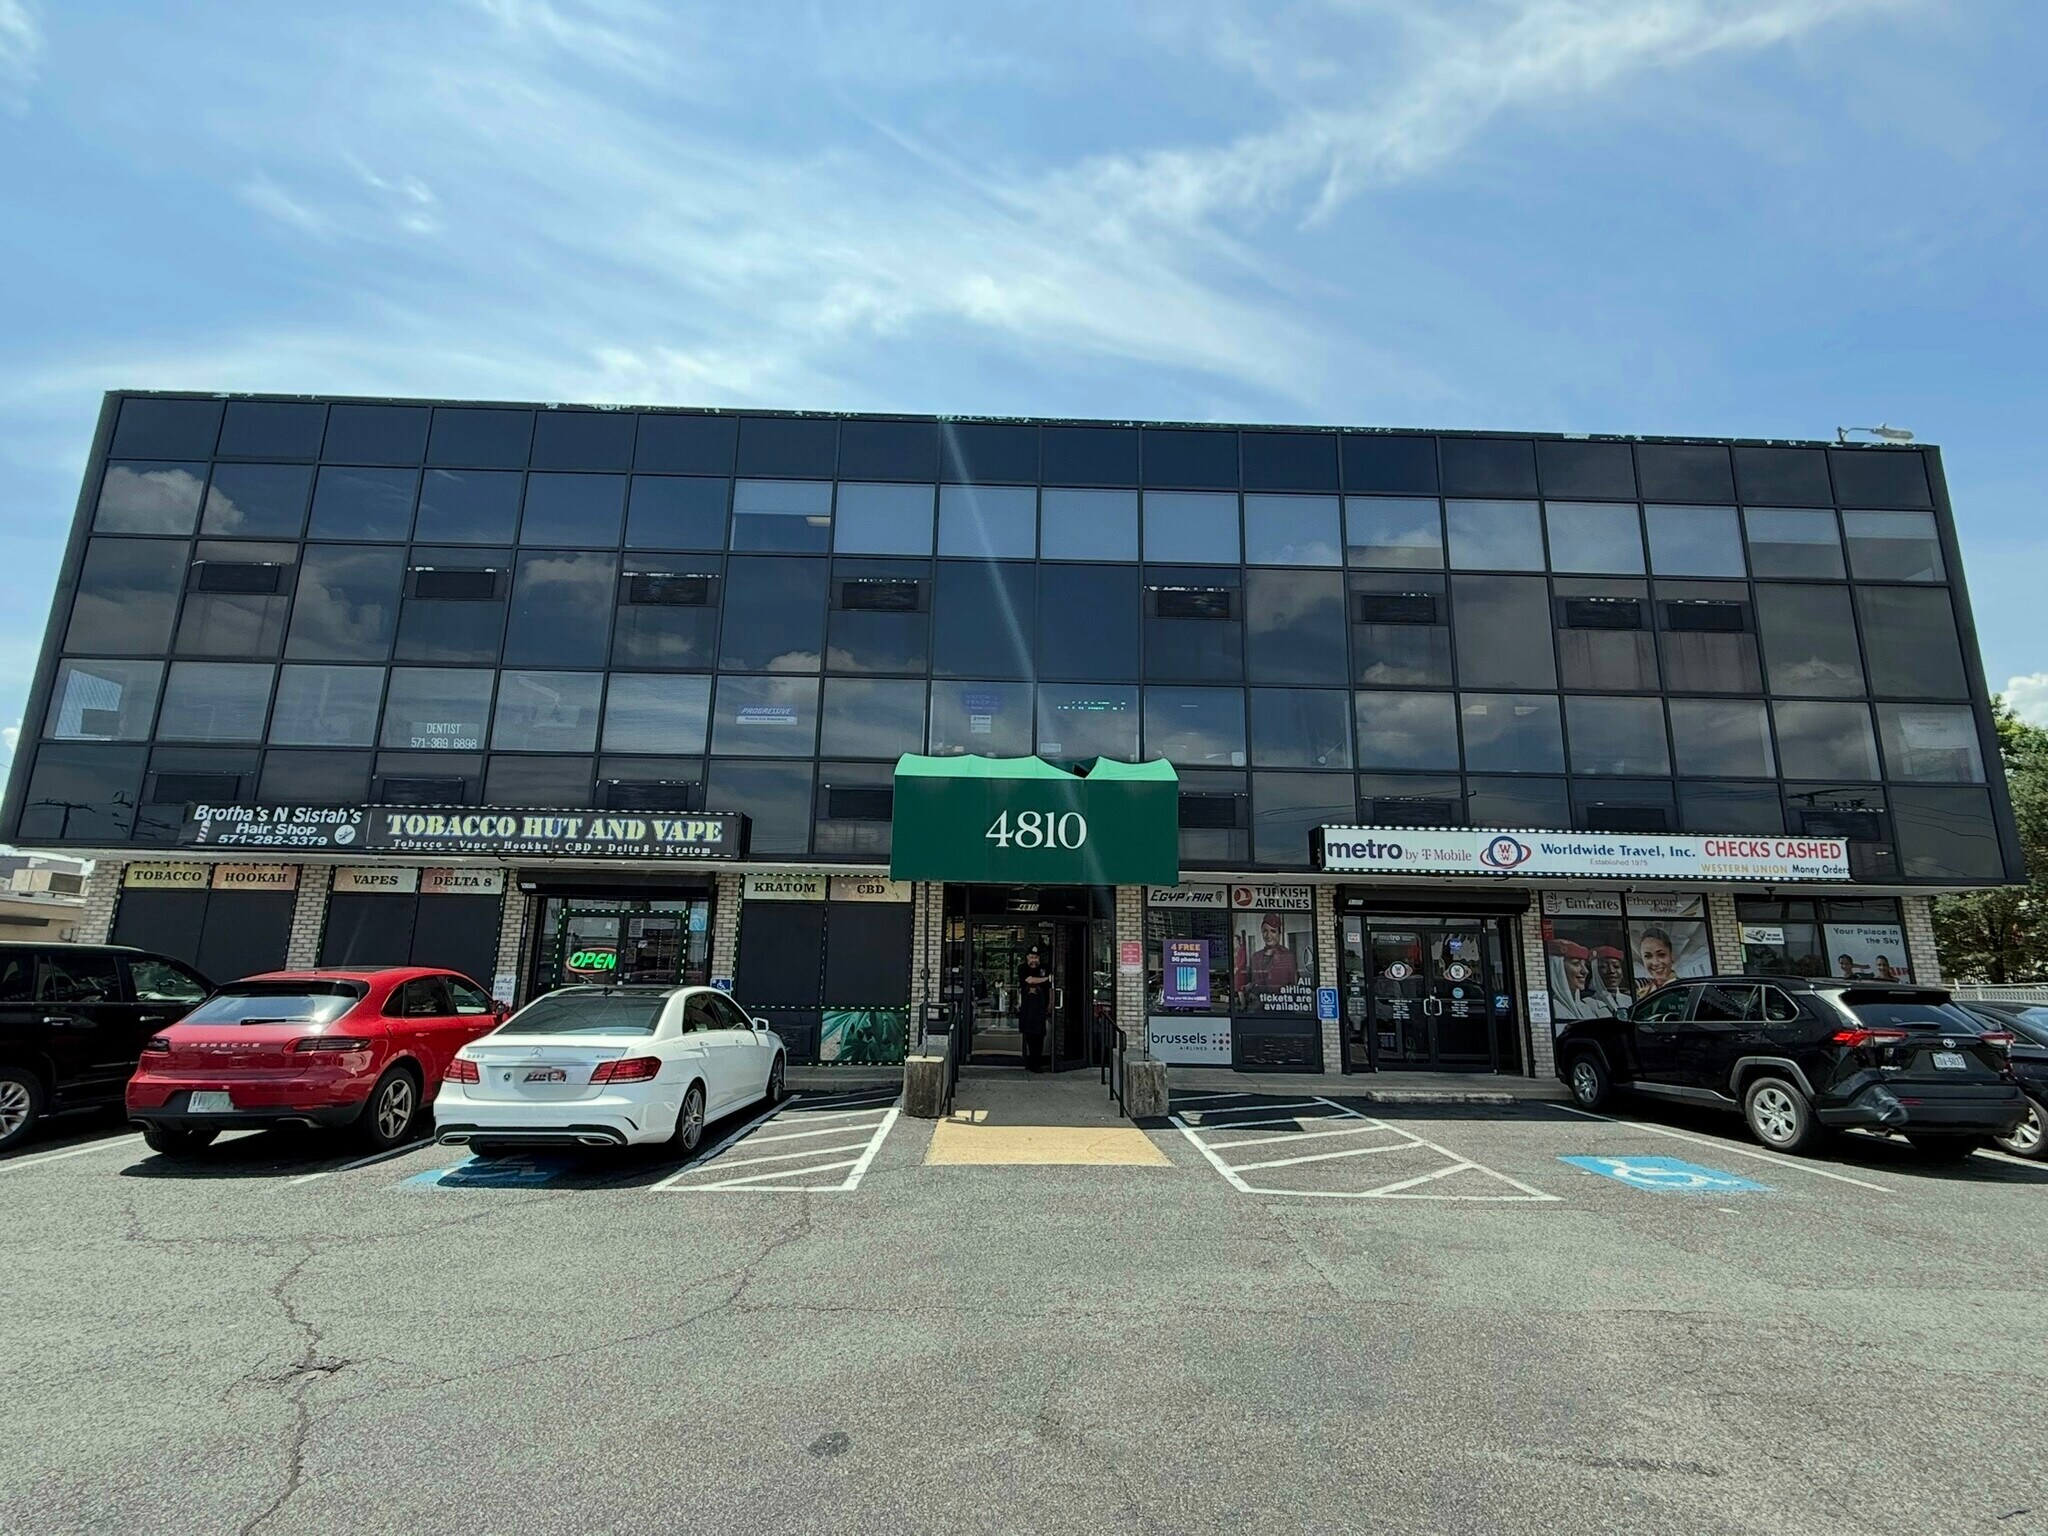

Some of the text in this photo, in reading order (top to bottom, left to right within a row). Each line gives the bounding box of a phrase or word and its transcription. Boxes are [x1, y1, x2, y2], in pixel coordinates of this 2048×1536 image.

[741, 707, 792, 715] PROGRESSIVE
[426, 723, 461, 734] DENTIST
[411, 737, 477, 750] 571-369 6898
[194, 805, 362, 824] Brotha's N Sistah's
[235, 822, 317, 836] Hair Shop
[386, 813, 723, 842] TOBACCO HUT AND VAPE
[985, 810, 1087, 849] 4810
[218, 834, 328, 846] 571-282-3379
[394, 839, 442, 848] Tobacco
[459, 840, 487, 849] Vape
[504, 841, 549, 850] Hookha
[565, 842, 592, 851] CBD
[608, 843, 641, 852] Delta
[666, 845, 711, 854] Kratom
[1327, 839, 1402, 860] metro
[1405, 849, 1419, 862] by
[1433, 849, 1472, 861] Mobile
[1541, 843, 1696, 858] Worldwide Travel, Inc.
[1704, 840, 1842, 859] CHECKS CASHED
[1590, 858, 1630, 866] Established
[1701, 863, 1788, 874] WESTERN UNION
[1792, 863, 1820, 876] Money
[133, 870, 203, 882] TOBACCO
[223, 872, 288, 883] HOOKAH
[352, 874, 399, 886] VAPES
[432, 875, 492, 887] DELTA 8
[753, 881, 816, 894] KRATOM
[856, 883, 885, 895] CBD
[1255, 898, 1309, 908] AIRLINES
[1171, 943, 1201, 951] 4 FREE
[1883, 937, 1899, 945] Sky
[569, 951, 617, 970] OPEN
[1298, 977, 1311, 986] All
[1280, 985, 1312, 995] airline
[1259, 993, 1294, 1002] tickets
[1263, 1002, 1312, 1012] available!
[1151, 1032, 1208, 1044] brussels
